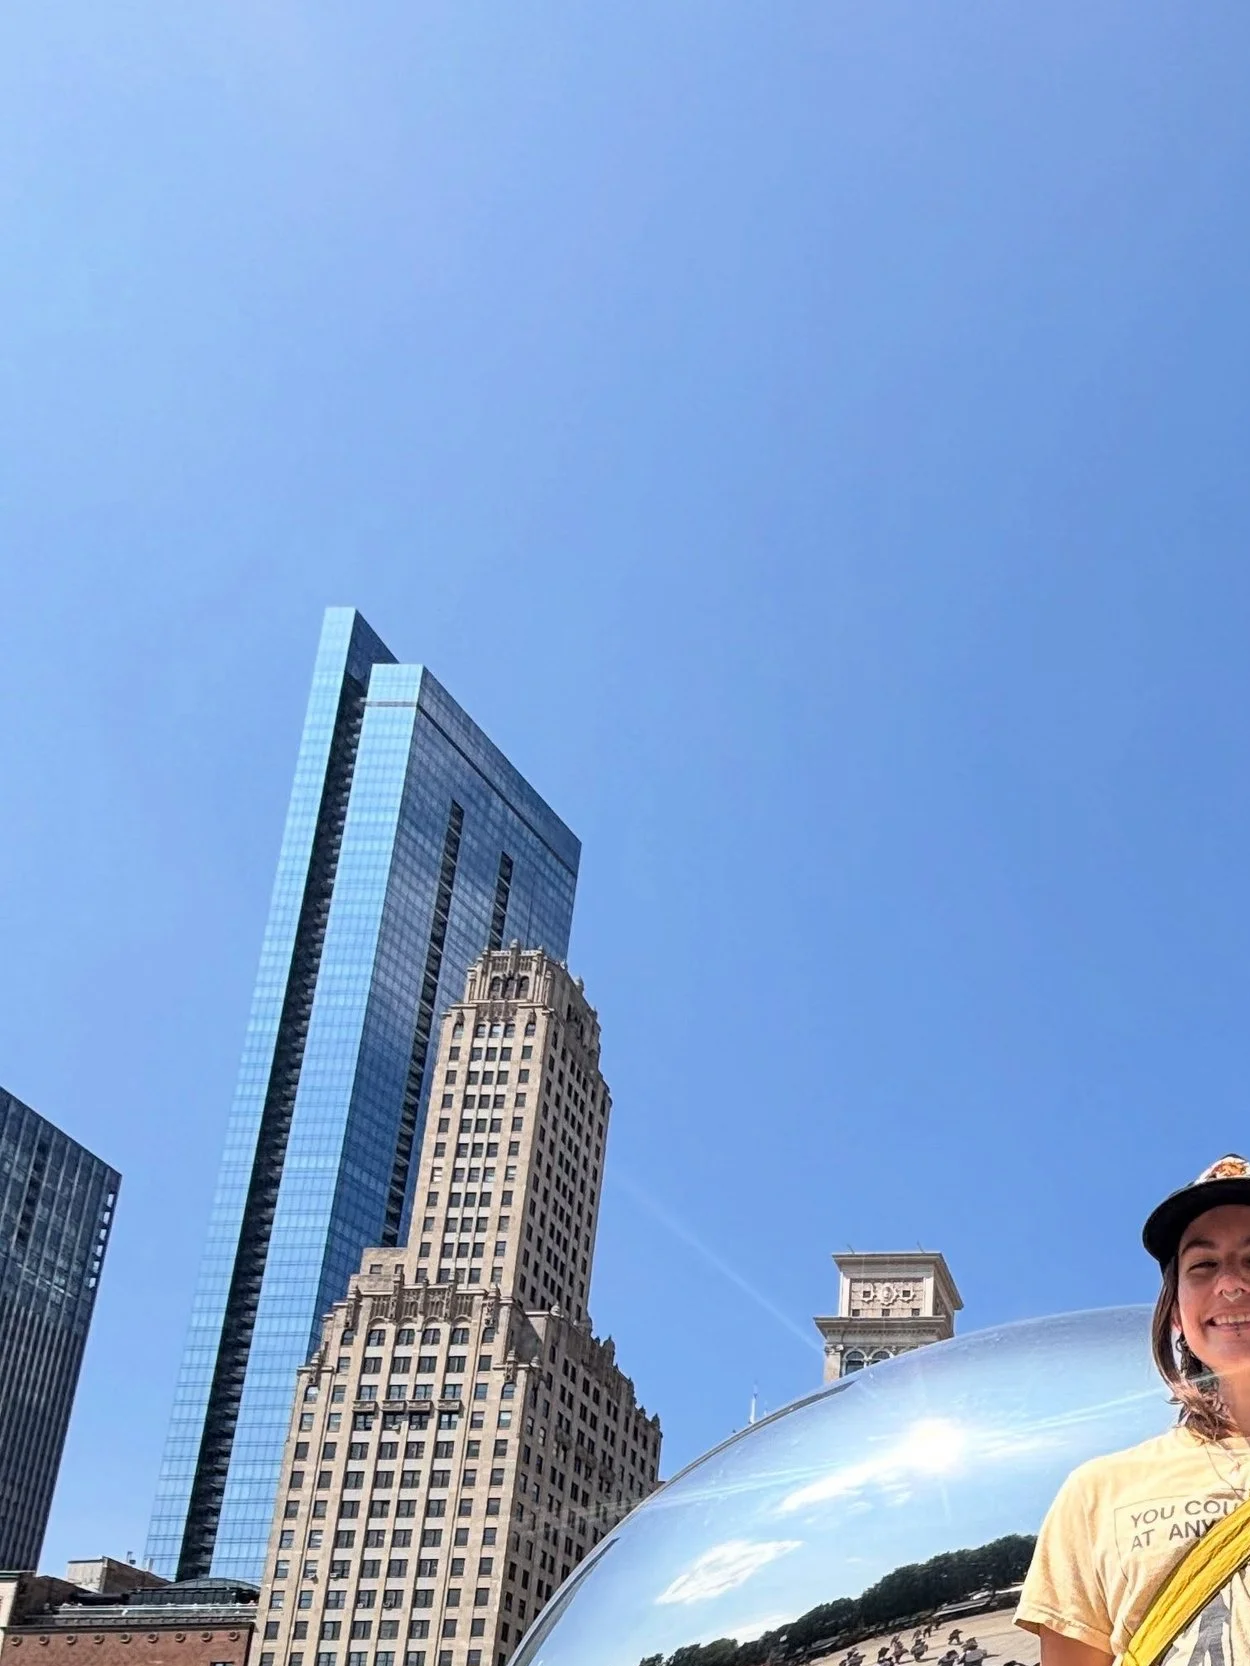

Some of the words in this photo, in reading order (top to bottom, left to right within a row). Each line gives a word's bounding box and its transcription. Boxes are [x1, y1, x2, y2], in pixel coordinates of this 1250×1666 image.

[1130, 1505, 1176, 1529] YOU
[1184, 1499, 1239, 1516] COU
[1130, 1528, 1156, 1553] AT
